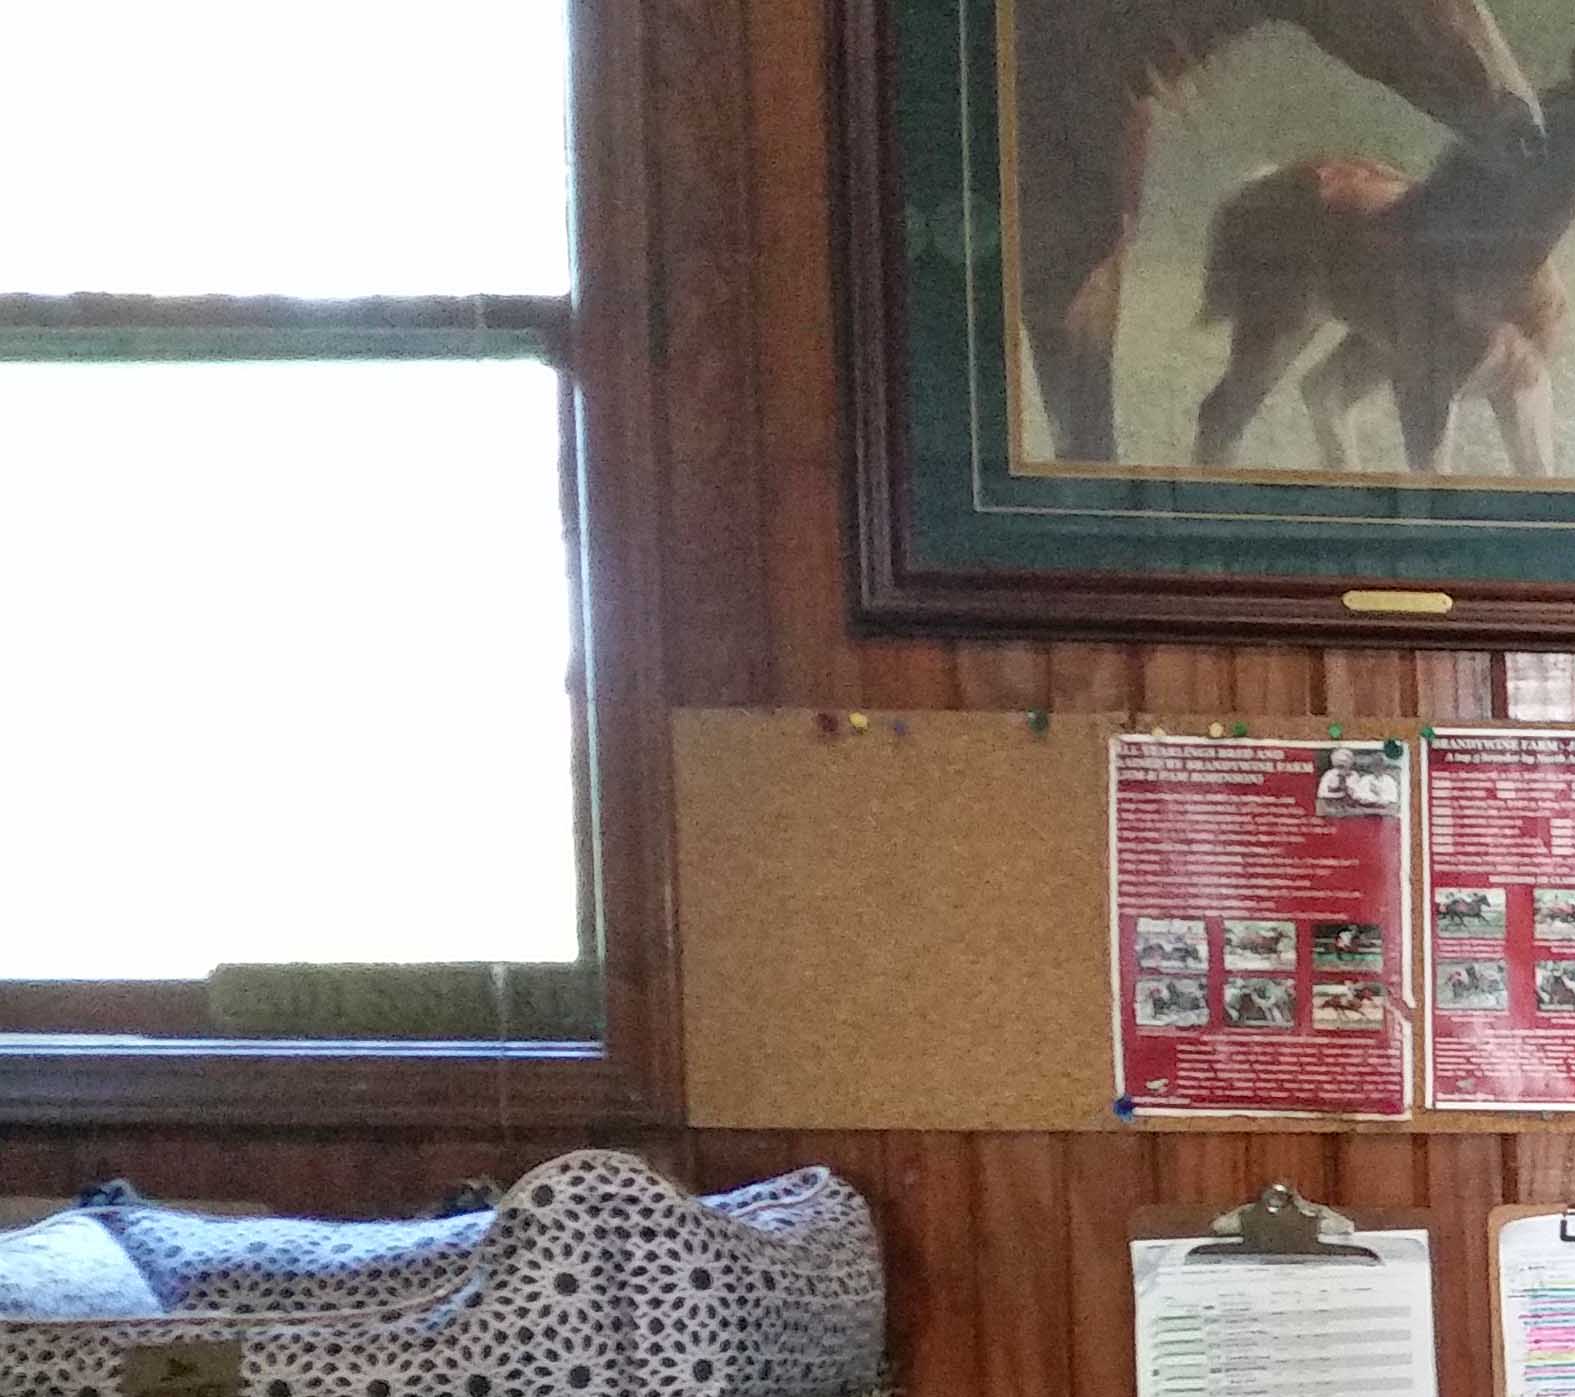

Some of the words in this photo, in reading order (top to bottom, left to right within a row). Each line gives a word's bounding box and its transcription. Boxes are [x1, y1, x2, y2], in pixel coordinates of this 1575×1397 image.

[1432, 738, 1519, 750] BRANDYWINE
[1521, 739, 1559, 751] FARM
[1277, 762, 1314, 773] FARM
